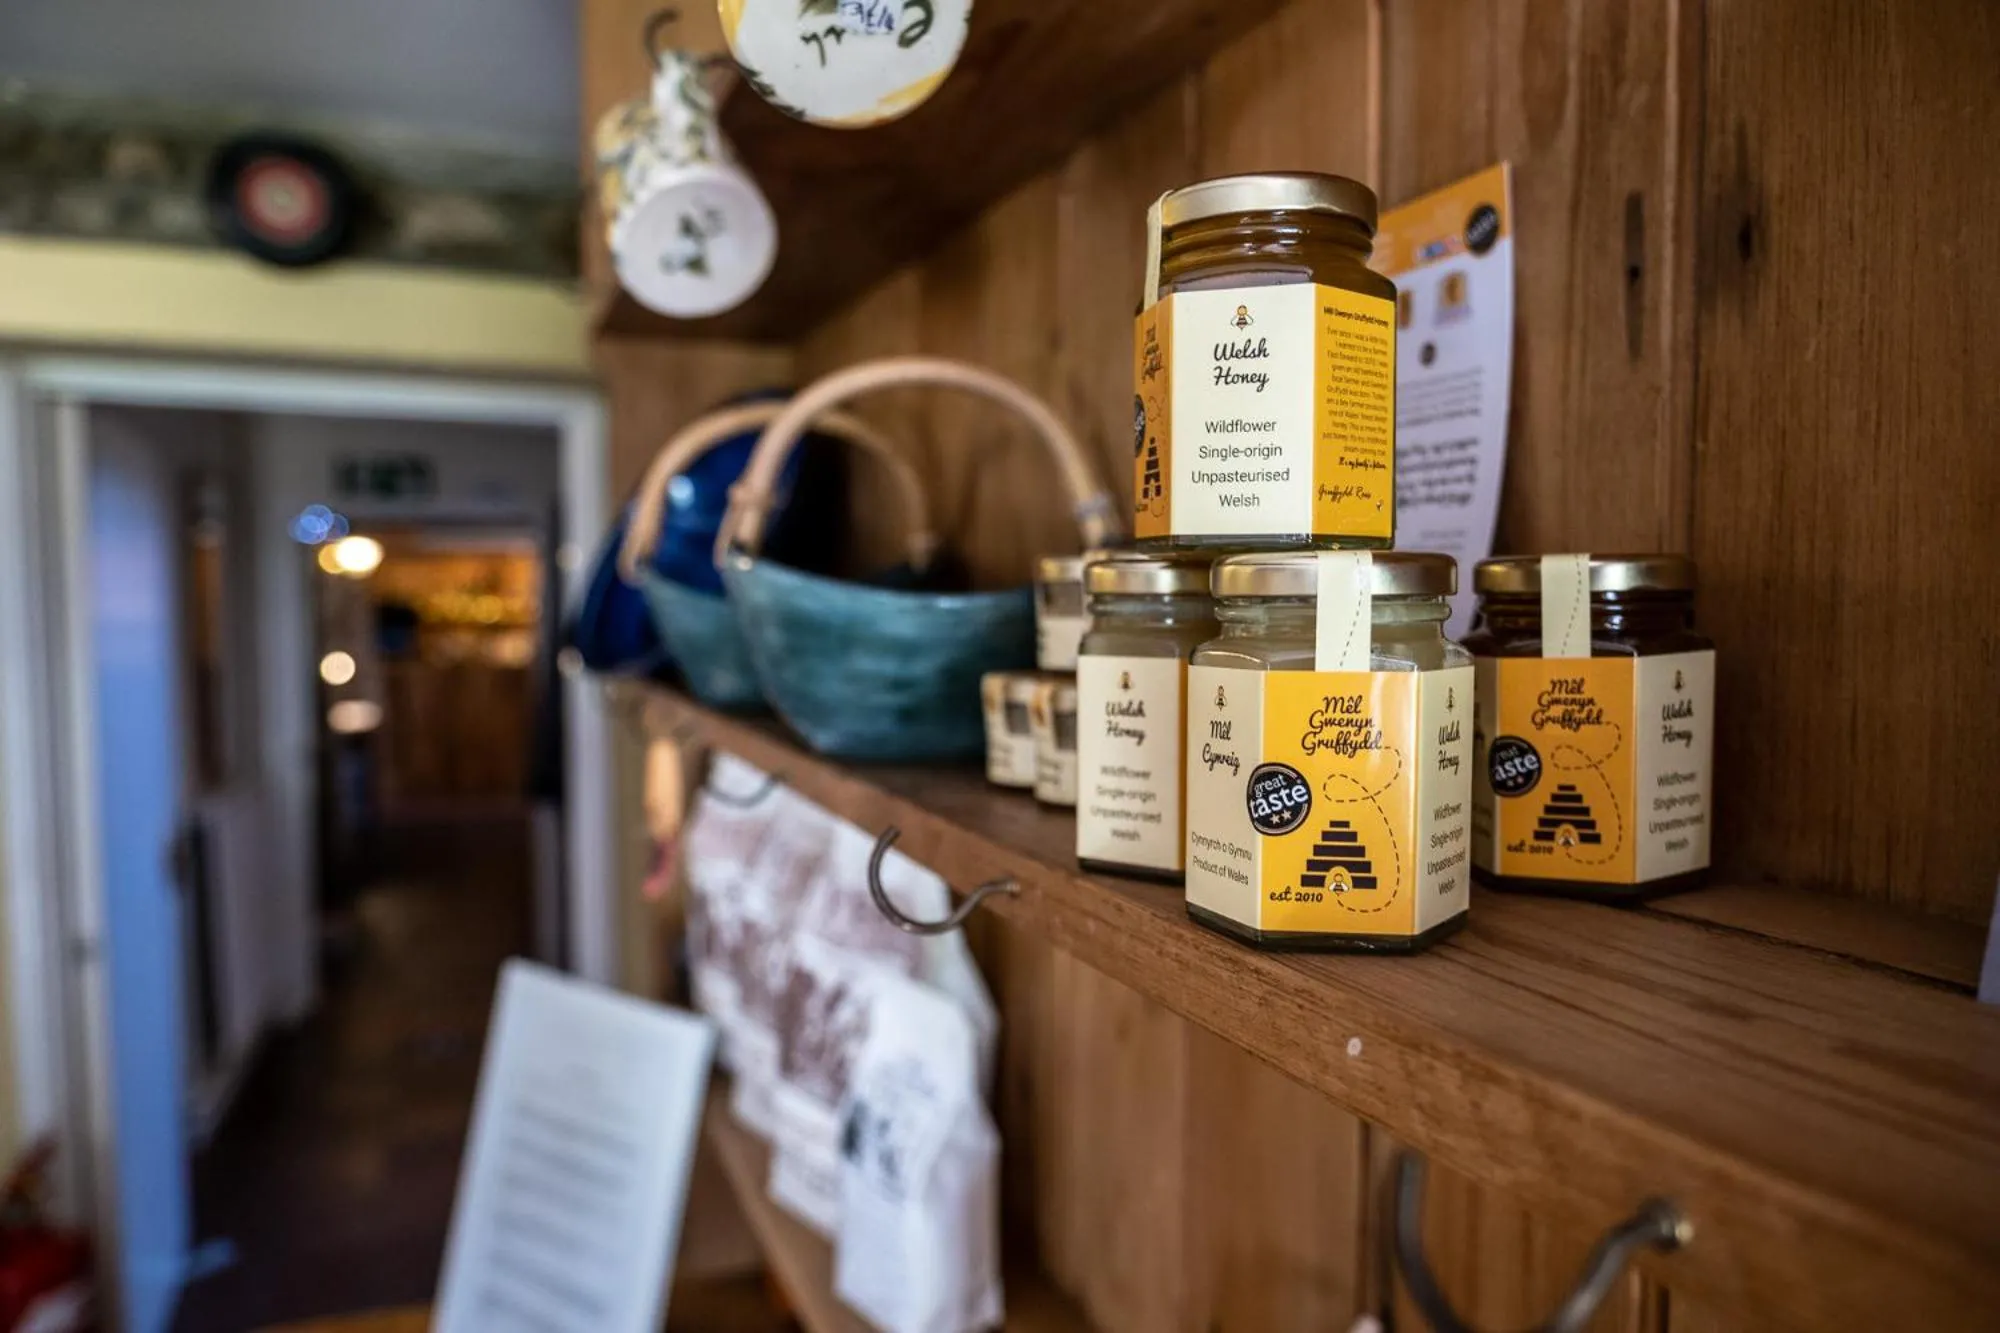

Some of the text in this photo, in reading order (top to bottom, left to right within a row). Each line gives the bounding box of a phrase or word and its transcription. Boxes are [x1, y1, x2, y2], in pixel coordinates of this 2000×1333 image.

[1213, 337, 1269, 361] Welsh
[1213, 366, 1269, 392] Honey
[1205, 420, 1276, 434] Wildflower
[1199, 444, 1282, 460] Single-origin
[1191, 468, 1289, 485] Unpasteurised
[1219, 493, 1260, 507] Welsh
[1549, 677, 1586, 694] Mêl
[1105, 700, 1146, 718] Welsh
[1322, 695, 1363, 714] Mêl
[1537, 691, 1596, 712] Gwenyn
[1662, 701, 1694, 721] Welsh
[1210, 720, 1232, 740] Mêl
[1308, 709, 1375, 736] Gwenyn
[1531, 709, 1604, 732] Gruffydd
[1105, 720, 1146, 746] Honey
[1438, 720, 1460, 745] Welsh
[1662, 725, 1694, 748] Honey
[1301, 730, 1383, 758] Gruffydd
[1202, 742, 1240, 776] Cymreig
[1438, 750, 1460, 776] Honey
[1494, 754, 1539, 780] aste
[1100, 766, 1151, 780] Wildflower
[1656, 772, 1696, 787] Wildflower
[1254, 774, 1287, 798] great
[1250, 784, 1309, 818] taste
[1433, 802, 1462, 822] Wildflower
[1110, 828, 1141, 842] Welsh
[1506, 840, 1526, 854] est
[1192, 856, 1249, 886] Product of Wales
[1270, 886, 1324, 902] est 2010
